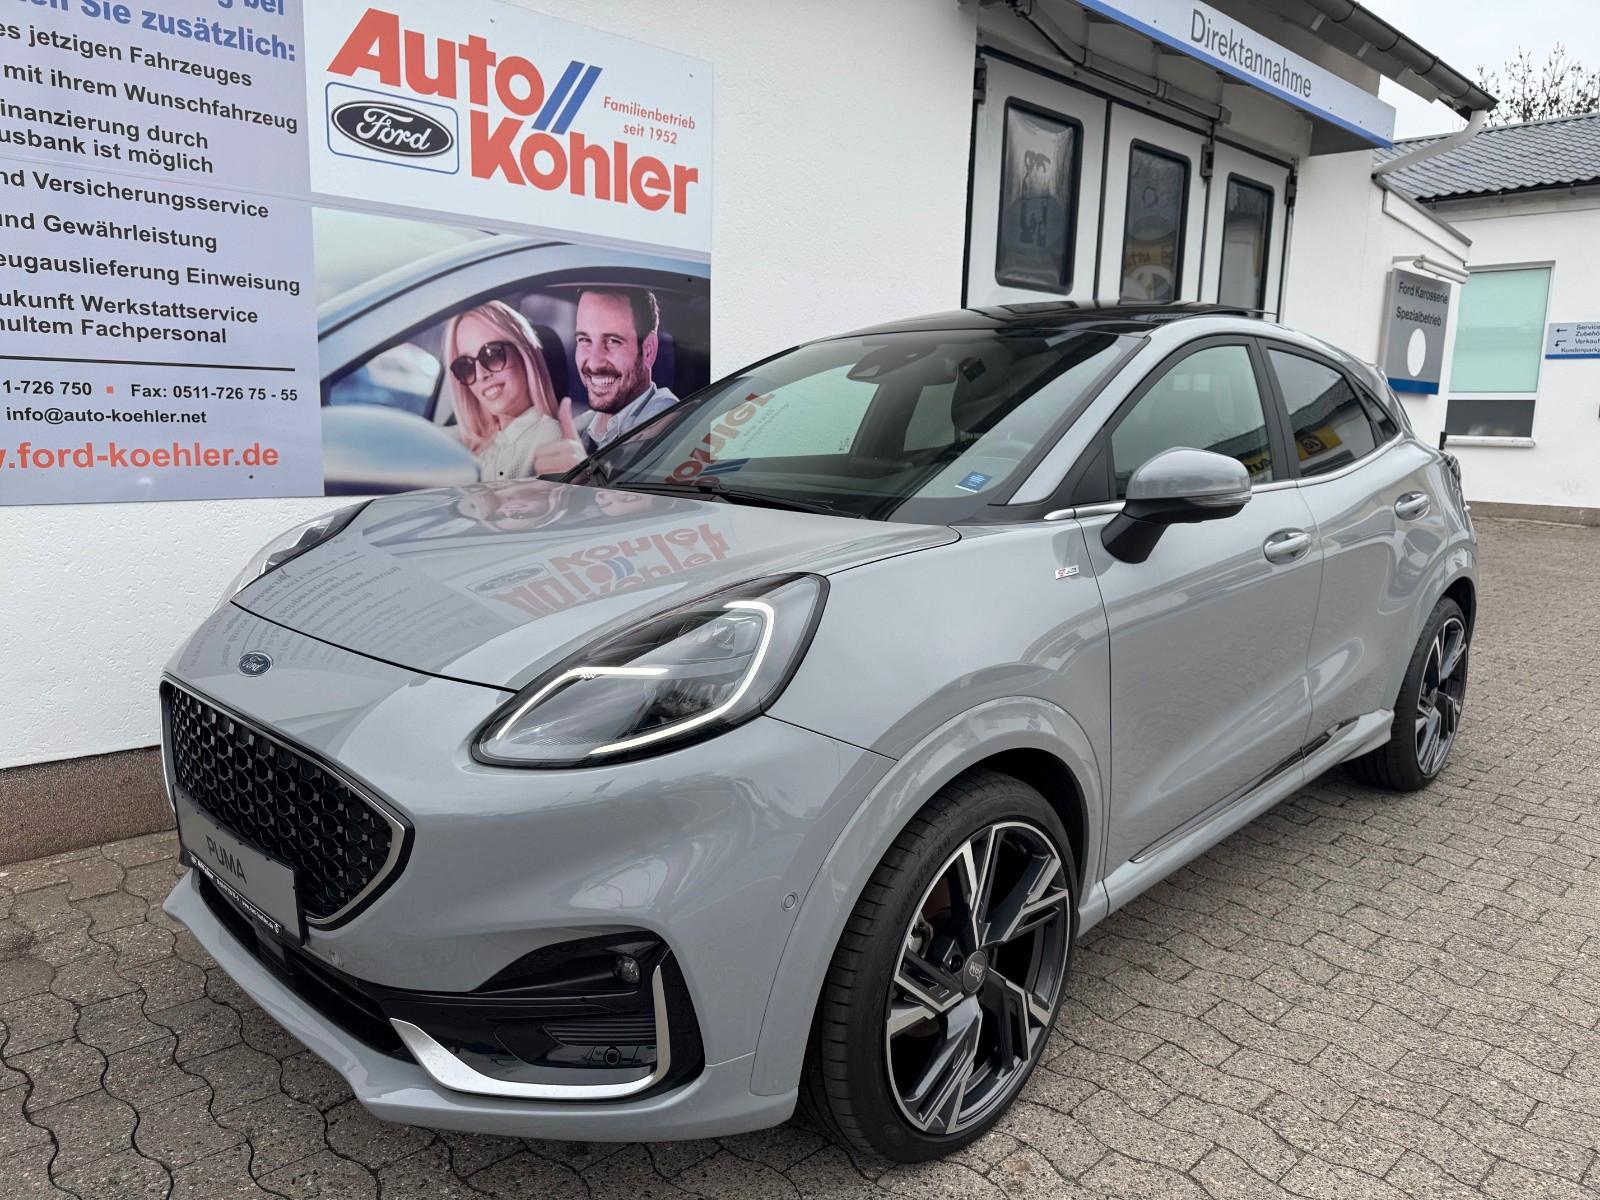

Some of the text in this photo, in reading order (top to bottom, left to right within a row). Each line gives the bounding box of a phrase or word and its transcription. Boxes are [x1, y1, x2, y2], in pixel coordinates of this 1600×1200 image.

[80, 0, 295, 61] Sie zusätzlich:
[28, 24, 122, 61] jetzigen
[130, 46, 253, 87] Fahrzeuges
[326, 8, 545, 116] Auto
[1190, 8, 1312, 98] Direktannahme
[4, 63, 299, 134] mit ihrem Wunschfahrzeug
[603, 95, 696, 130] Familienbetrieb
[147, 125, 209, 149] durch
[355, 107, 432, 150] Ford
[623, 124, 678, 145] seit 1952
[93, 139, 121, 160] ist
[128, 148, 214, 173] möglich
[32, 171, 269, 218] Versicherungsservice
[0, 212, 218, 253] nd Gewährleistung
[186, 267, 301, 296] Einweisung
[1398, 281, 1449, 305] Ford Karosserie
[81, 294, 259, 323] Werkstattservice
[1396, 306, 1442, 327] Spezialbetrieb
[80, 319, 227, 344] Fachpersonal
[2, 379, 54, 396] 1-726
[60, 381, 92, 396] 750
[131, 384, 168, 398] Fax:
[172, 385, 244, 400] 0511-726
[248, 387, 266, 400] 75
[281, 388, 298, 401] 55
[6, 406, 208, 425] info@auto-koehler.net
[205, 835, 248, 885] PUMA
